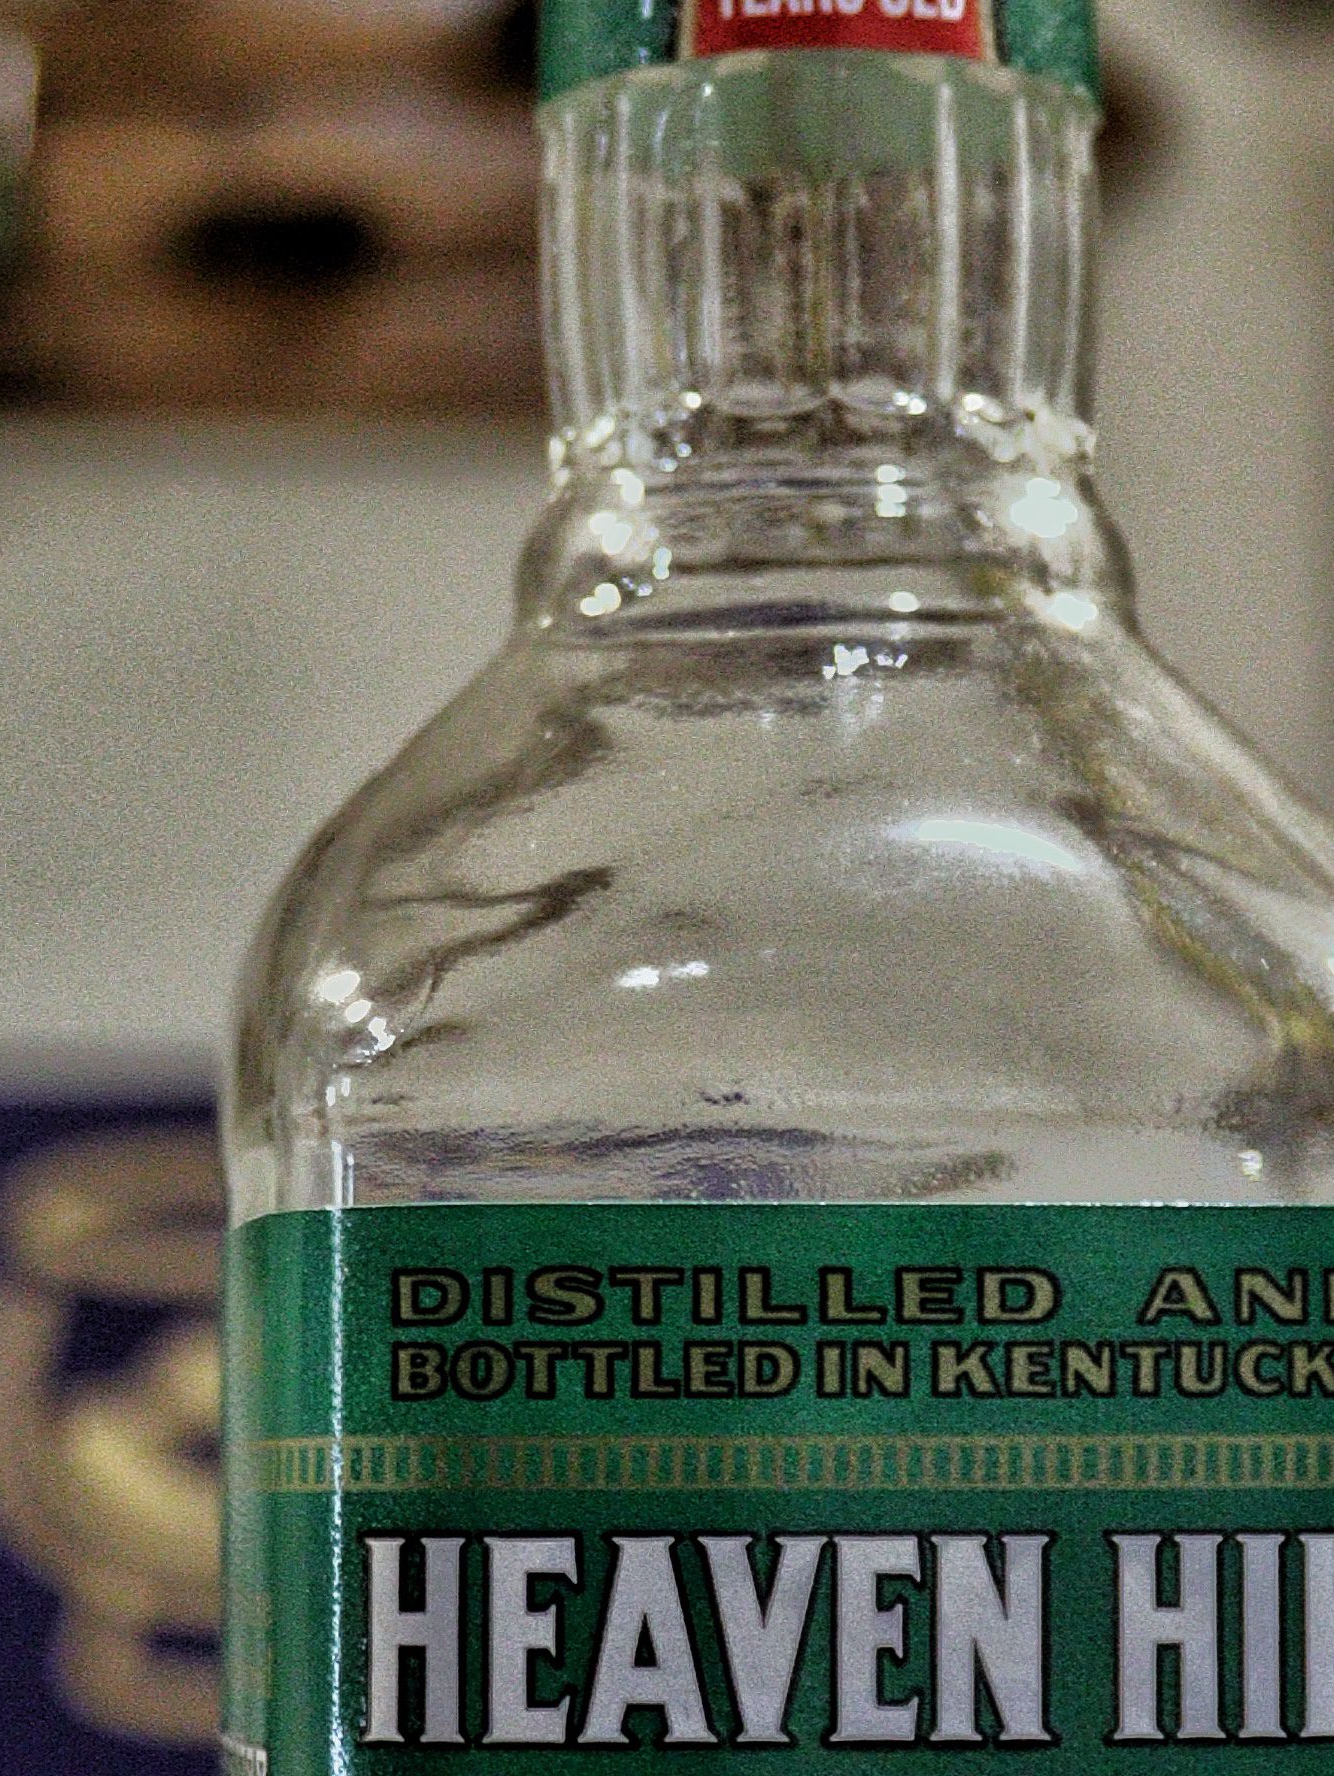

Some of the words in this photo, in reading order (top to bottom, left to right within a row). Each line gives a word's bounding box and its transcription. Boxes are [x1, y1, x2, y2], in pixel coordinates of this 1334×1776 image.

[391, 1265, 1062, 1325] DISTILLED
[390, 1339, 799, 1401] BOTTLED
[815, 1338, 911, 1399] IN
[357, 1533, 1059, 1746] HEAVEN
